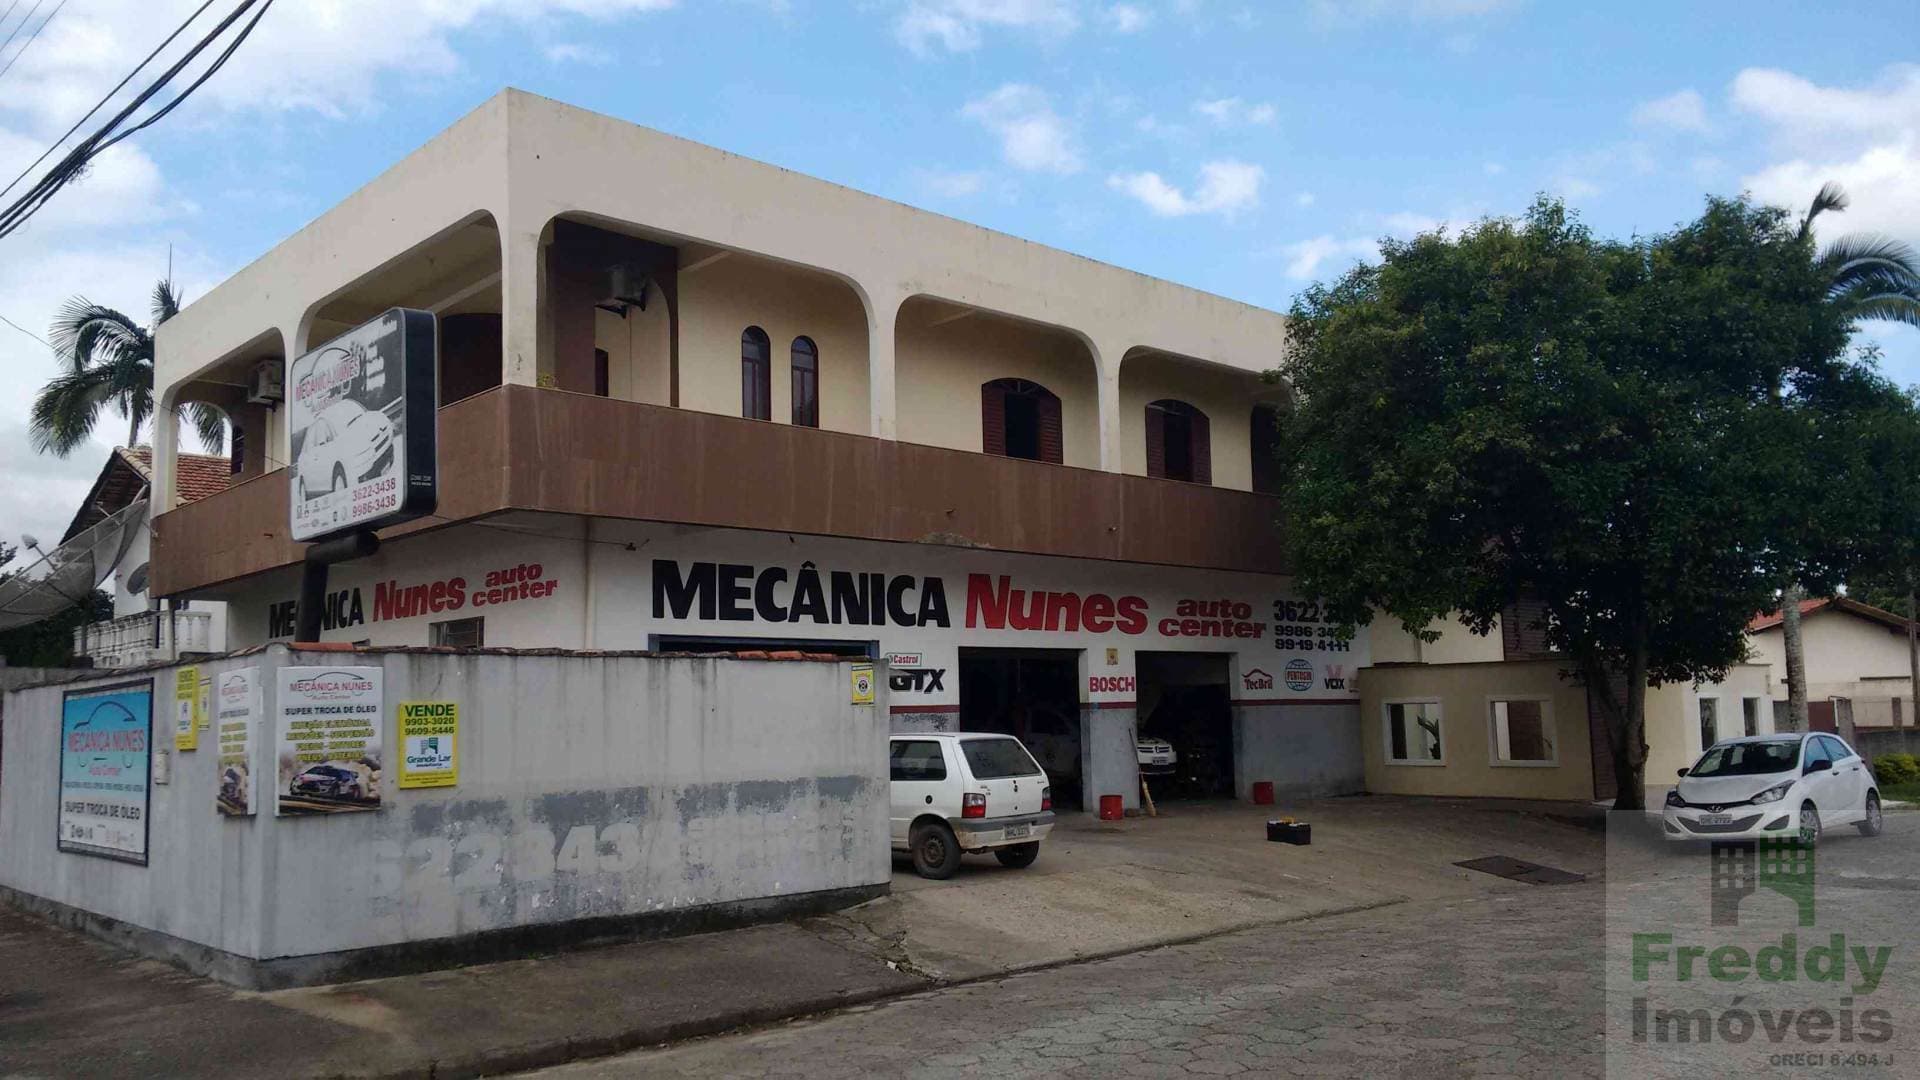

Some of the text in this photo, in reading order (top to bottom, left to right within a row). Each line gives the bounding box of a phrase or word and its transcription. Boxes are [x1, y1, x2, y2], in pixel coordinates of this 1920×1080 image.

[352, 478, 396, 501] 3622-3438
[352, 494, 396, 518] 9986-3438
[486, 563, 543, 587] auto
[373, 577, 466, 622] Nunes
[472, 580, 557, 607] center
[652, 559, 950, 628] MECÂNICA
[269, 587, 364, 638] MENICA
[966, 573, 1149, 635] Nunes
[1176, 599, 1252, 620] auto
[1158, 618, 1266, 638] center
[893, 655, 919, 664] Castrol
[341, 681, 373, 691] NUNES
[889, 668, 946, 694] GTX
[1089, 676, 1135, 692] BOSCH
[285, 707, 312, 715] SUPER
[314, 706, 341, 715] TROCA
[405, 704, 455, 717] VENDE
[405, 717, 454, 726] 9903-3020
[405, 726, 454, 735] 9609-5446
[407, 754, 451, 763] Grande Lar
[65, 801, 85, 813] SUPER
